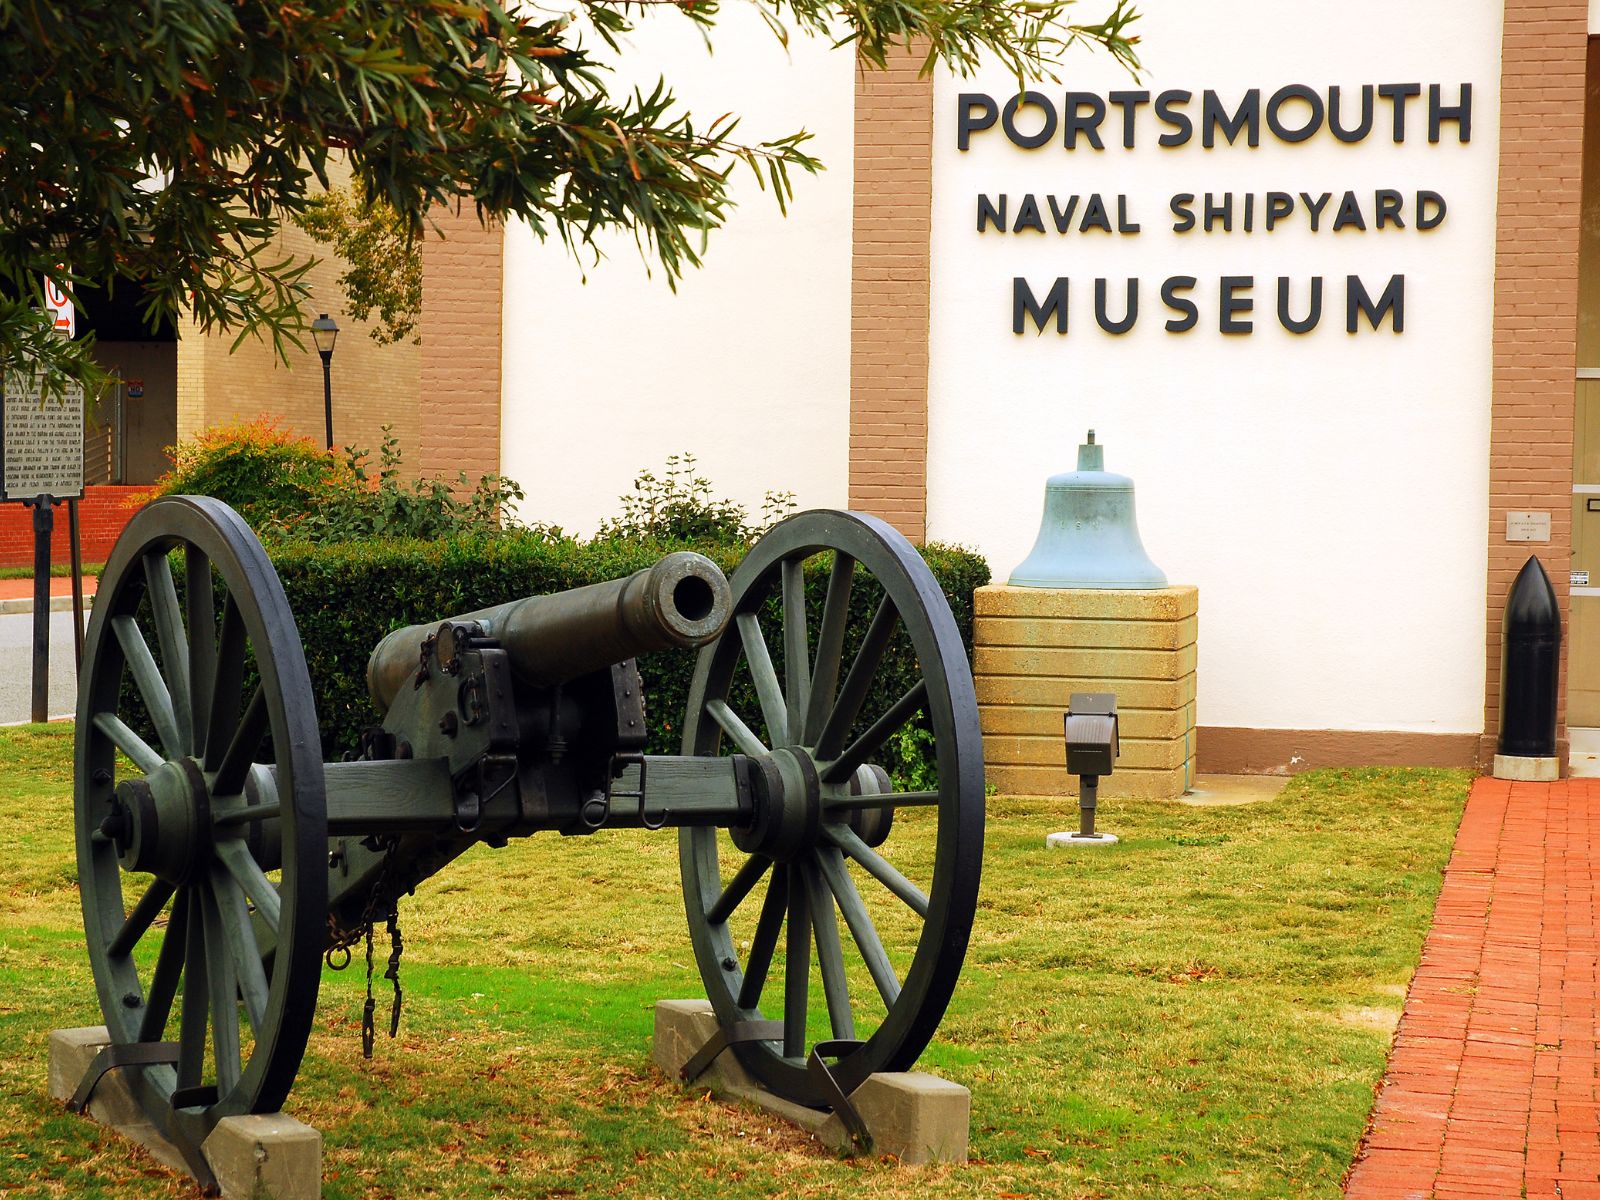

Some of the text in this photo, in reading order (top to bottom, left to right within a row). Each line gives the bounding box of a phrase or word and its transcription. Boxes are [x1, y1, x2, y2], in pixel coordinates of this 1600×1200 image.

[958, 83, 1472, 151] PORTSMOUTH
[977, 190, 1447, 233] NAVAL SHIPYARD
[1013, 274, 1405, 334] MUSEUM
